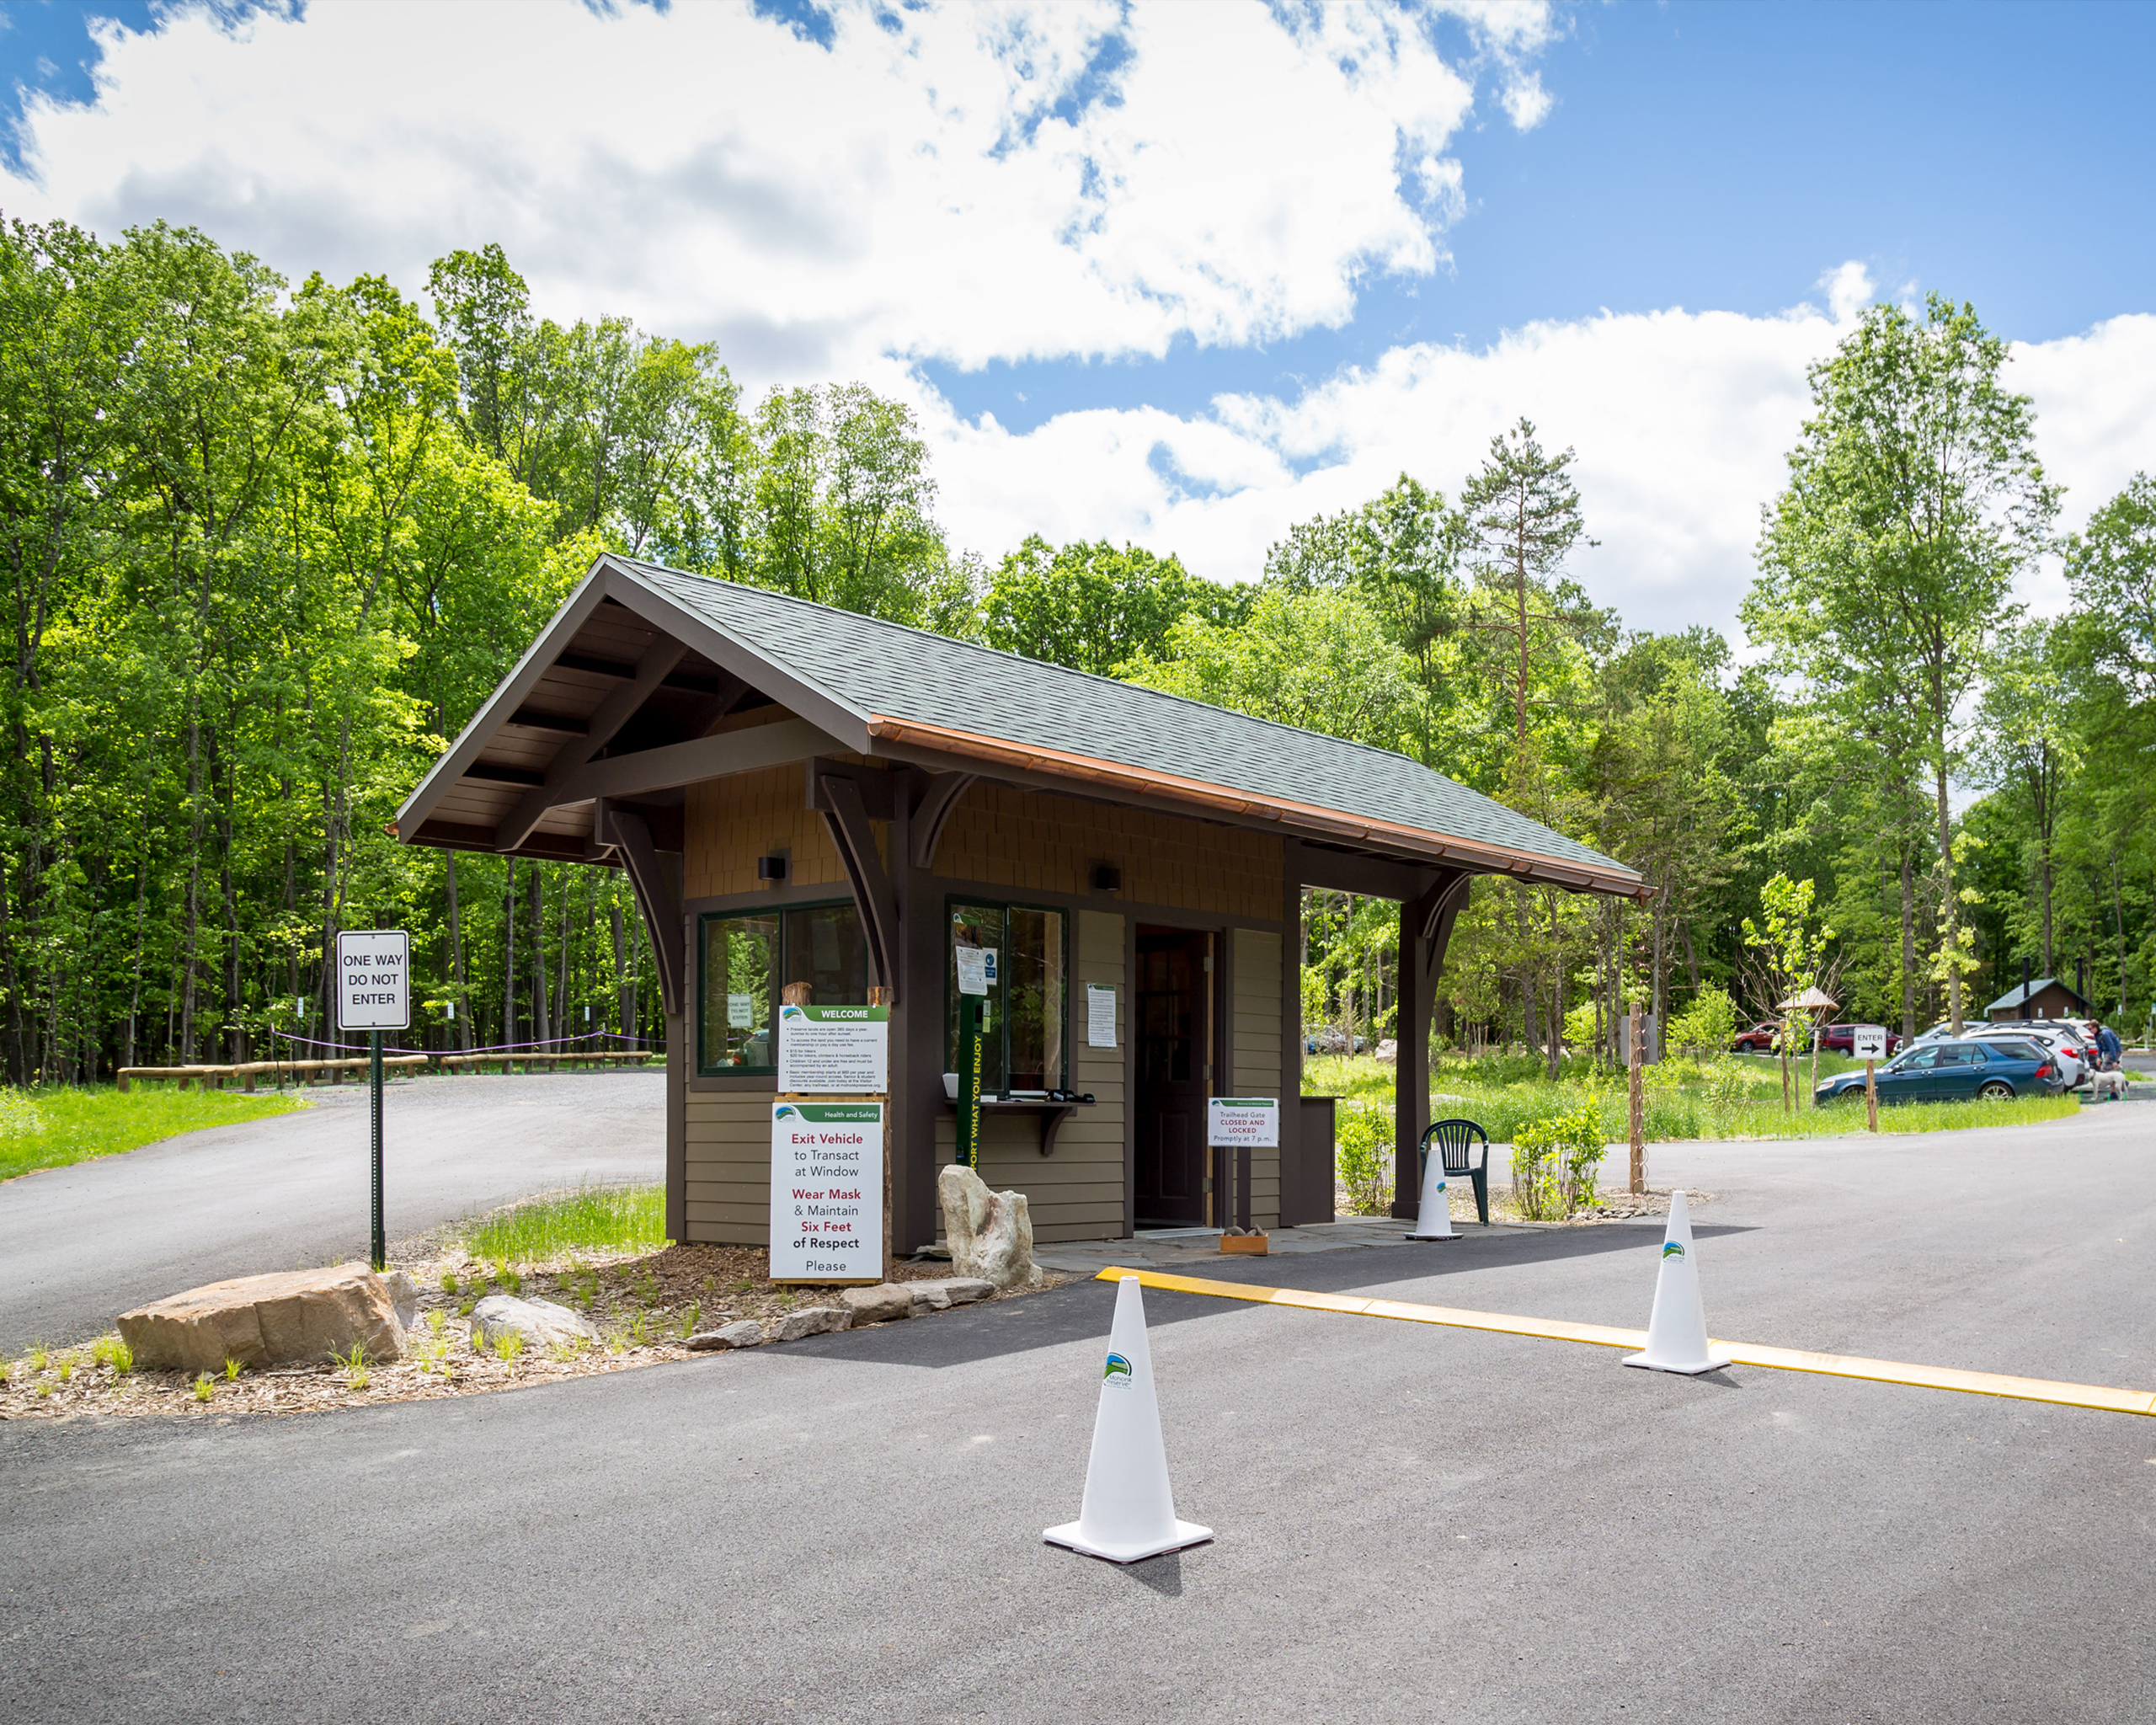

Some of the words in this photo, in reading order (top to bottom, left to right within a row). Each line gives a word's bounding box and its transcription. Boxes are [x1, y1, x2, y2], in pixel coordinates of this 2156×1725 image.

[344, 955, 371, 966] ONE
[376, 954, 403, 965] WAY
[349, 975, 367, 985] DO
[372, 975, 398, 985] NOT
[353, 994, 395, 1005] ENTER
[821, 1010, 868, 1018] WELCOME
[974, 1036, 982, 1073] ENJOY
[972, 1076, 980, 1103] YOU
[859, 1111, 878, 1119] Safety
[971, 1106, 979, 1139] WHAT
[792, 1134, 815, 1145] Exit
[819, 1133, 863, 1145] Vehicle
[794, 1151, 807, 1161] to
[810, 1150, 860, 1161] Transact
[794, 1167, 807, 1178] at
[809, 1166, 859, 1178] Window
[792, 1188, 825, 1199] Wear
[829, 1188, 862, 1199] Mask
[794, 1205, 803, 1215] &
[808, 1205, 859, 1215] Maintain
[801, 1220, 819, 1231] Six
[824, 1220, 852, 1231] Feet
[792, 1237, 807, 1248] of
[810, 1237, 860, 1251] Respect
[806, 1260, 846, 1271] Please
